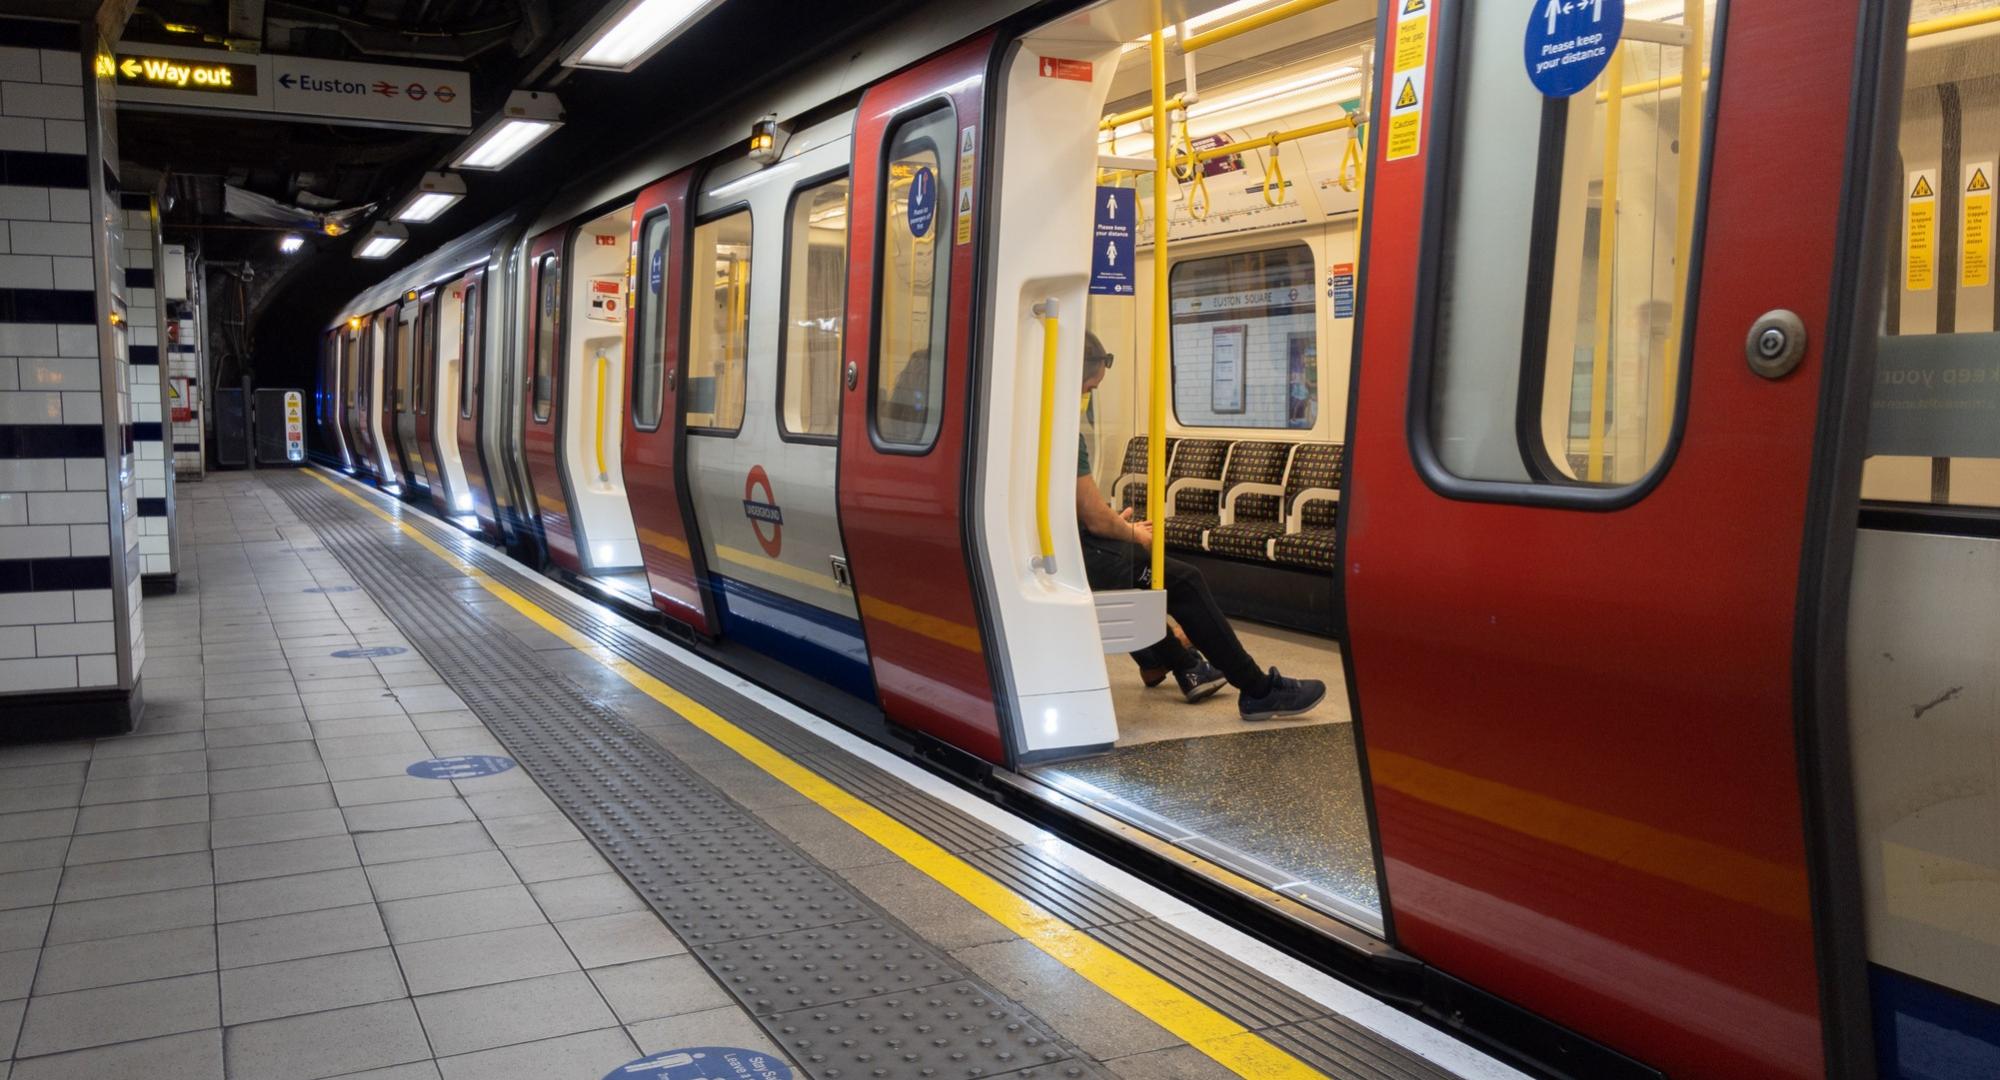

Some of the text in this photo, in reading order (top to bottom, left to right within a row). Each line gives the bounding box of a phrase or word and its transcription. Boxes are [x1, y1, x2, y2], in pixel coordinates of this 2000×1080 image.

[1542, 33, 1603, 56] Please keep
[1536, 46, 1606, 74] your distance
[143, 60, 190, 87] Way
[193, 67, 232, 86] out
[300, 75, 366, 95] Euston
[1213, 291, 1273, 308] EUSTON SQUARE
[723, 1053, 746, 1074] Leave
[749, 1056, 769, 1072] Stay
